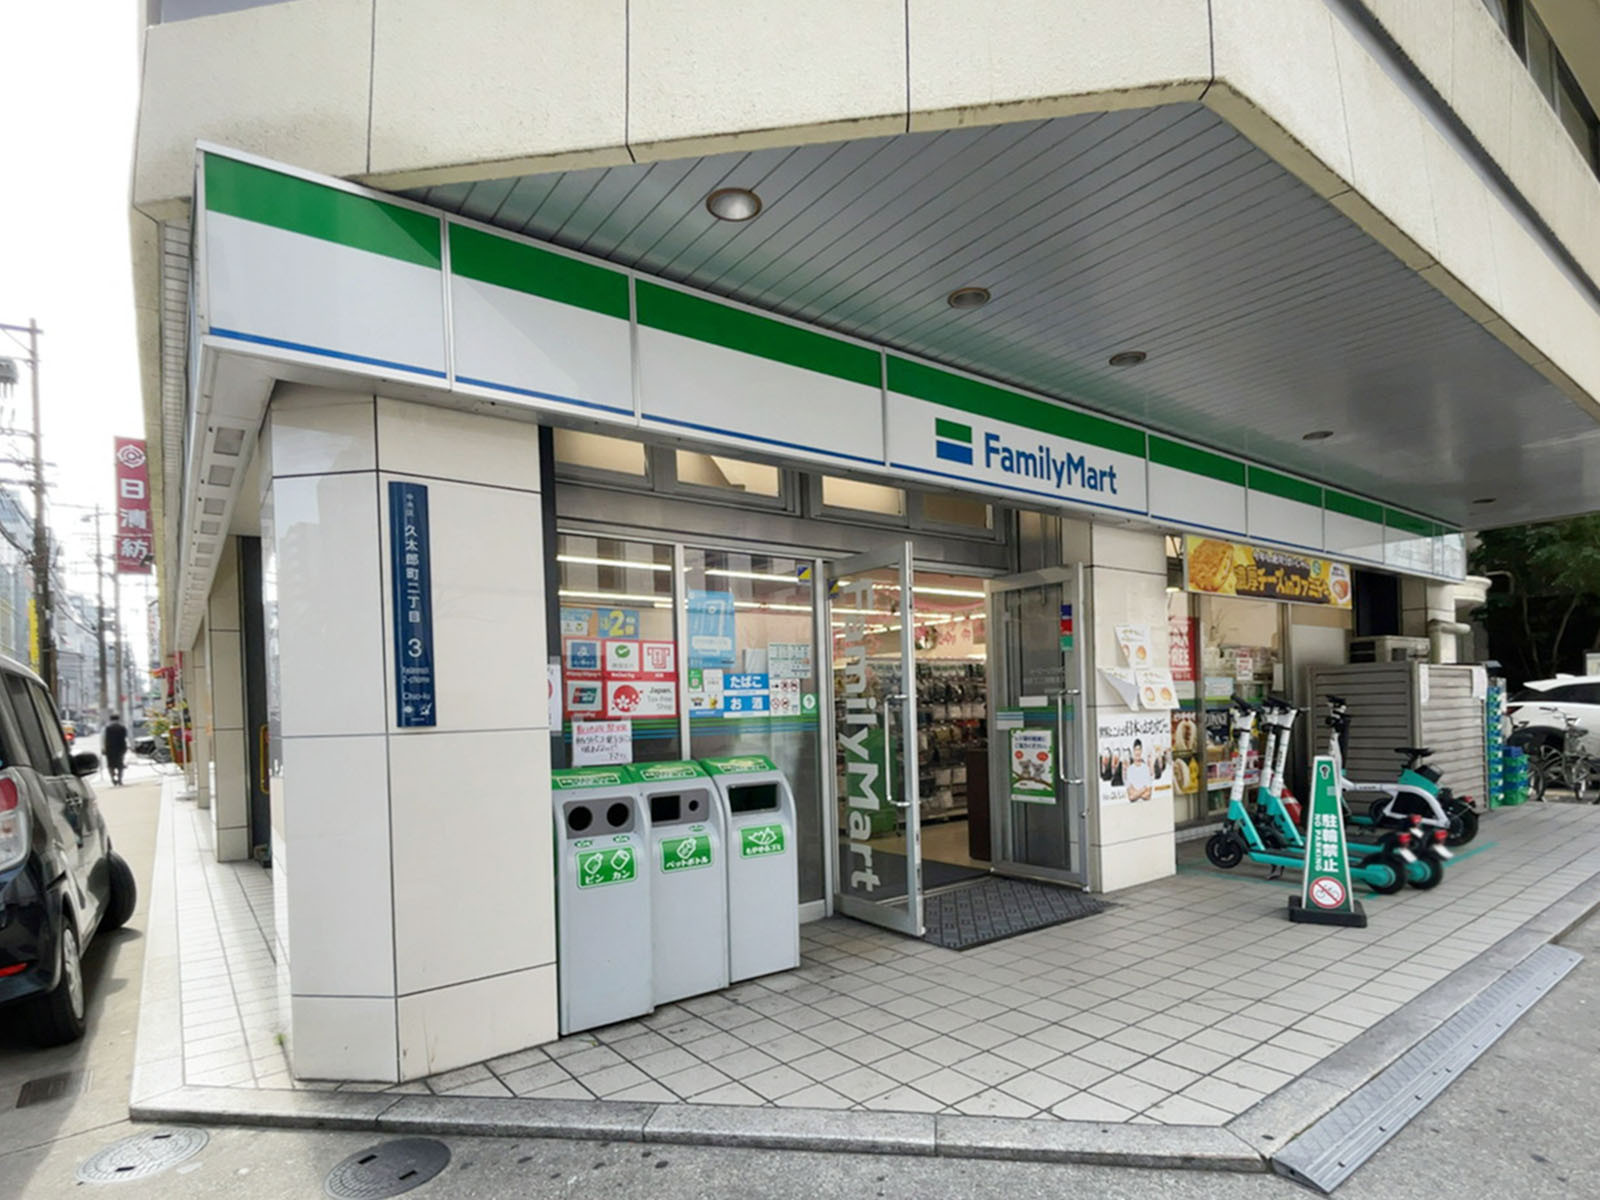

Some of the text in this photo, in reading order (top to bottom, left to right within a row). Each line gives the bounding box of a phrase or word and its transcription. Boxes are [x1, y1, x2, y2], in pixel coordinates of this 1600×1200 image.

[984, 431, 1118, 495] FamilyMart
[408, 638, 423, 658] 3
[730, 675, 762, 689] たばこ
[839, 578, 882, 893] FamilyMart
[1322, 813, 1339, 873] 駐輪禁止
[666, 856, 709, 868] ペットボトル
[585, 870, 631, 884] ビン カン
